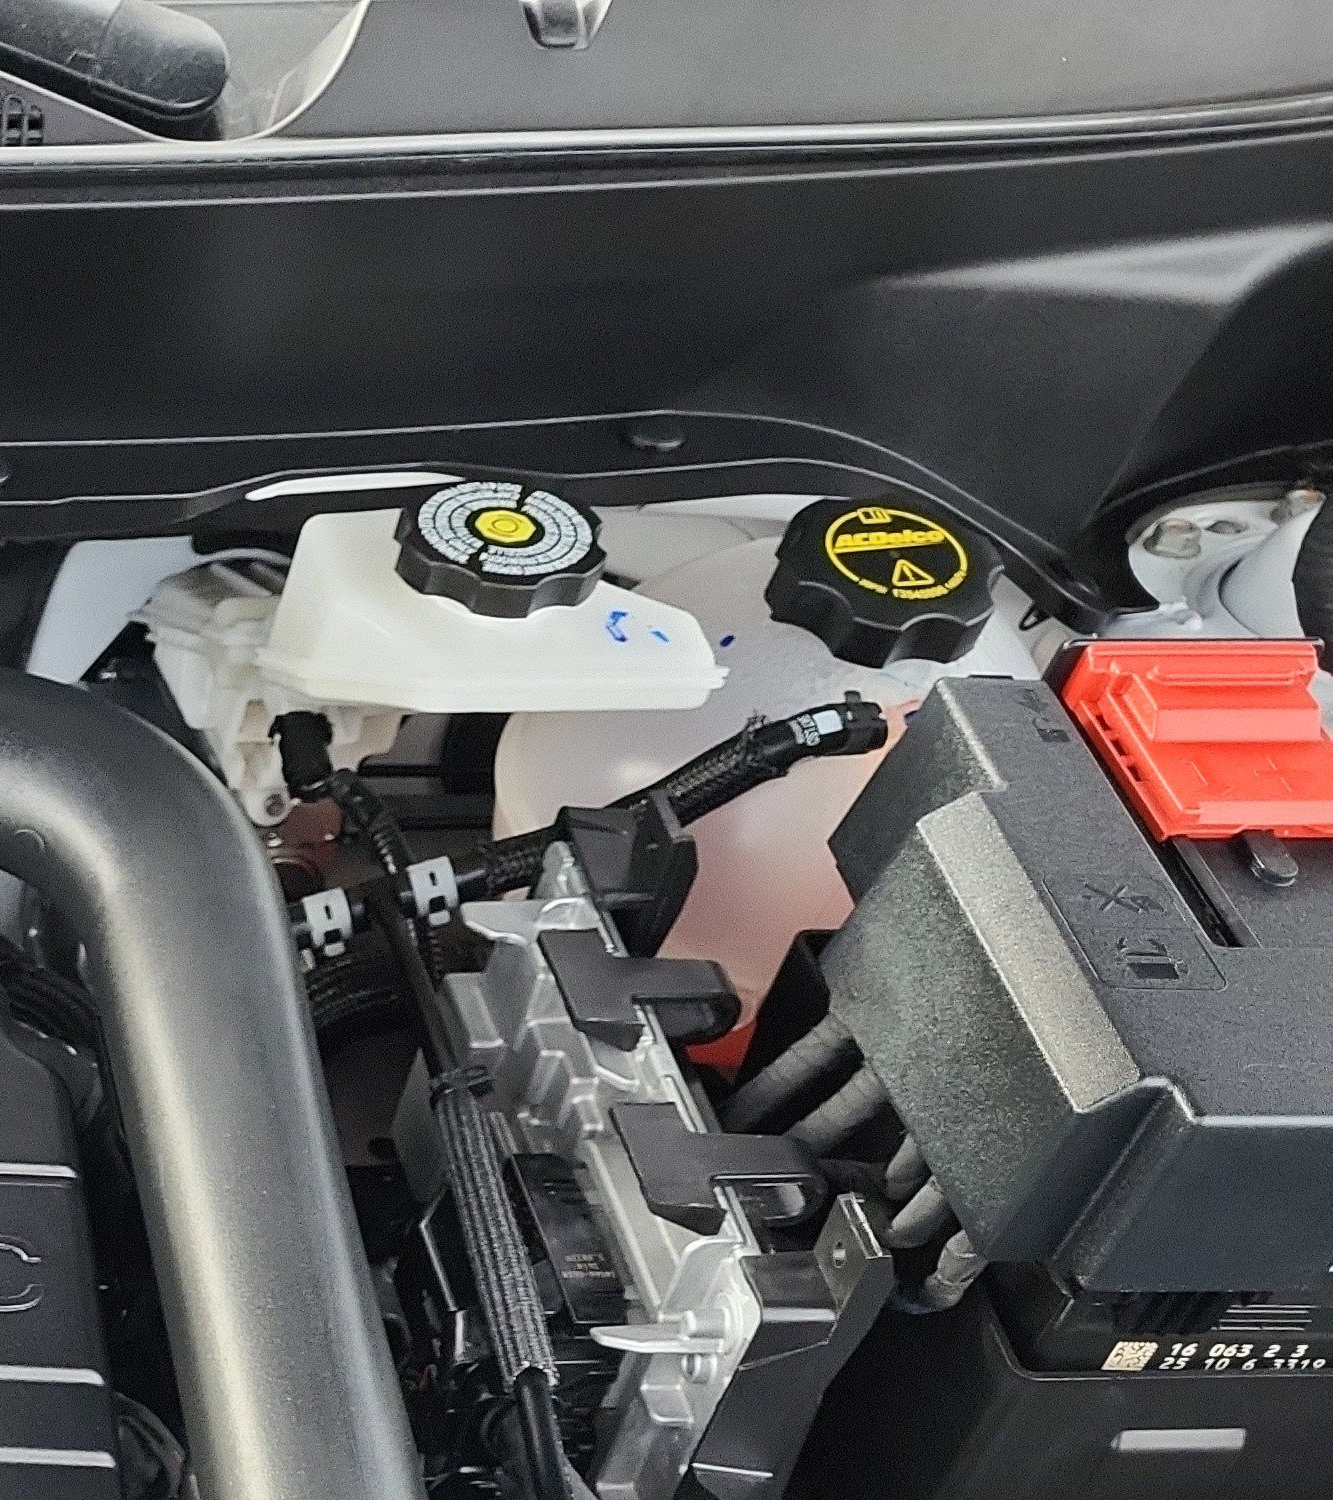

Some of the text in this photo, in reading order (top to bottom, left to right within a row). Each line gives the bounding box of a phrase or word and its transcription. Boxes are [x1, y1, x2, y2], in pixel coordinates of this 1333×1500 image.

[1170, 1342, 1199, 1357] 16
[1208, 1343, 1254, 1358] 063
[1263, 1344, 1281, 1358] 2
